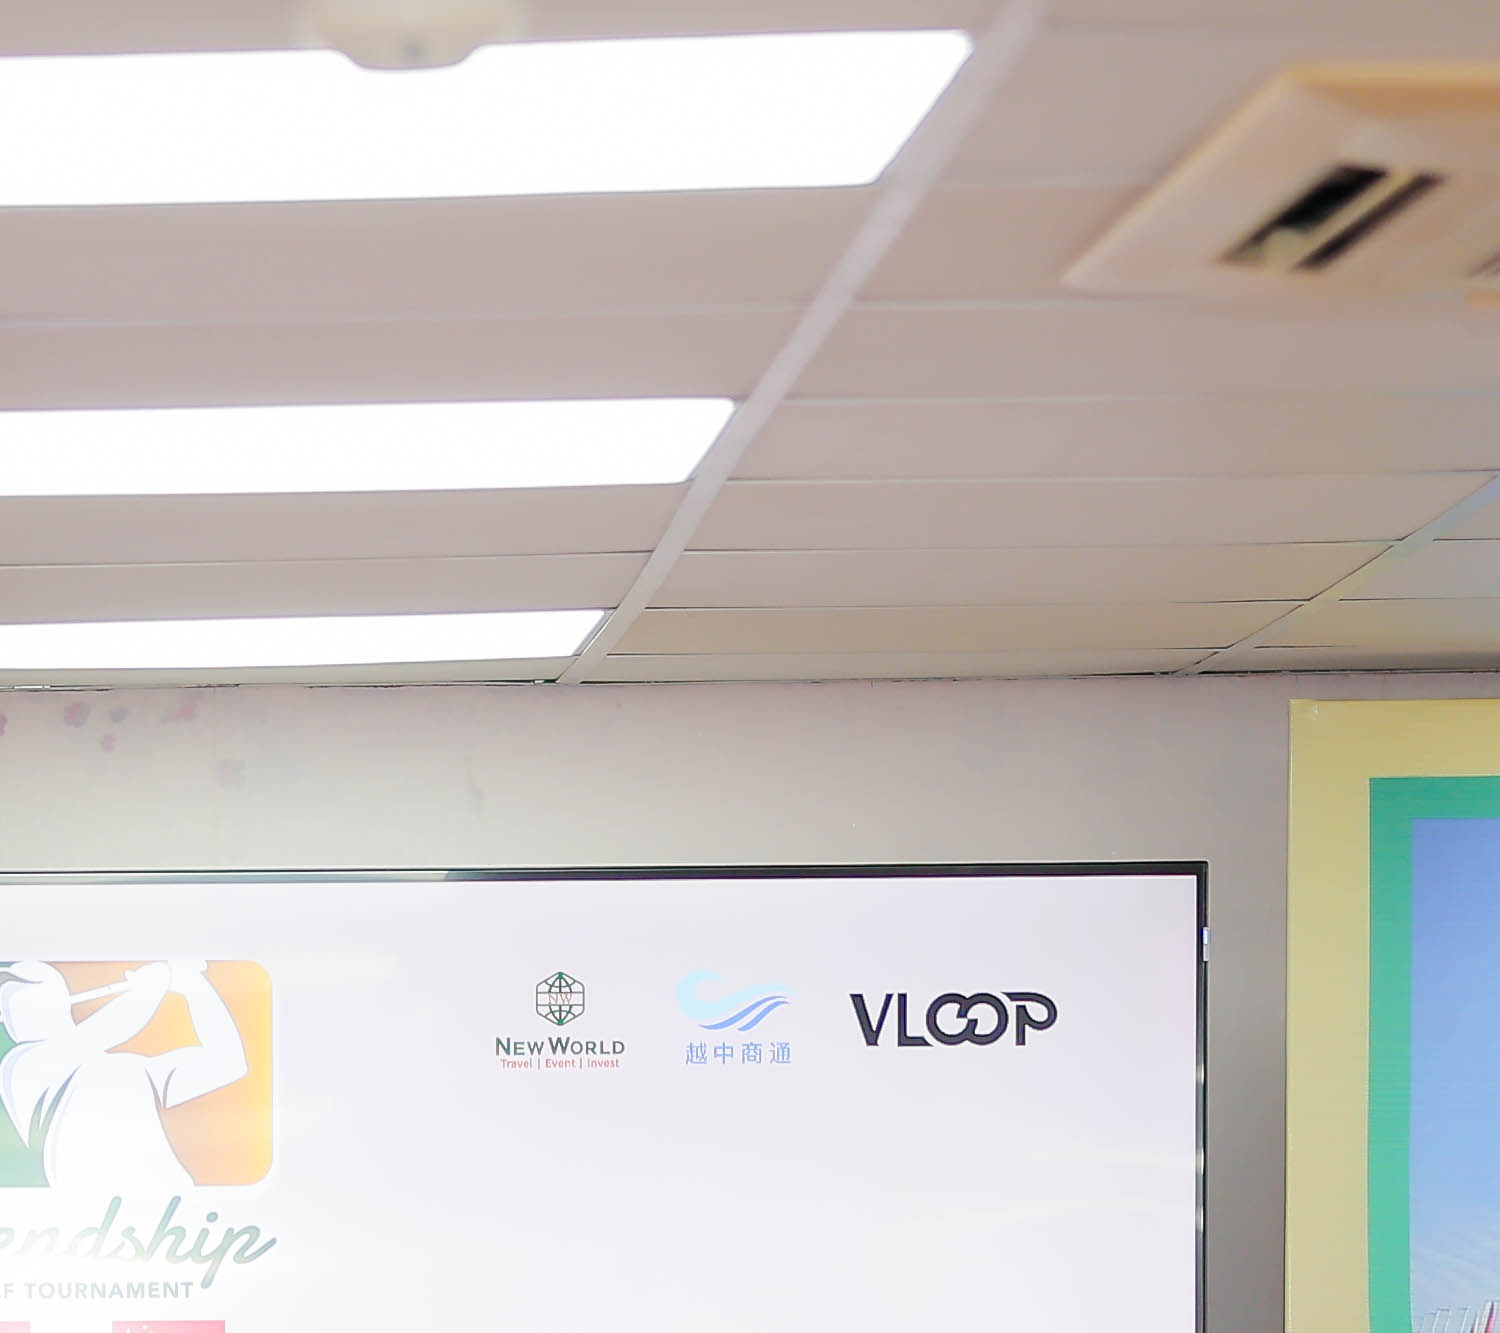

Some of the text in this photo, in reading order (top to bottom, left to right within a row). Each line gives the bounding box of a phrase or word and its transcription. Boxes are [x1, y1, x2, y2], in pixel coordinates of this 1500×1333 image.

[848, 991, 1059, 1049] VLOOP
[685, 1041, 792, 1065] 越中商通
[27, 1281, 194, 1300] TOURNAMENT
